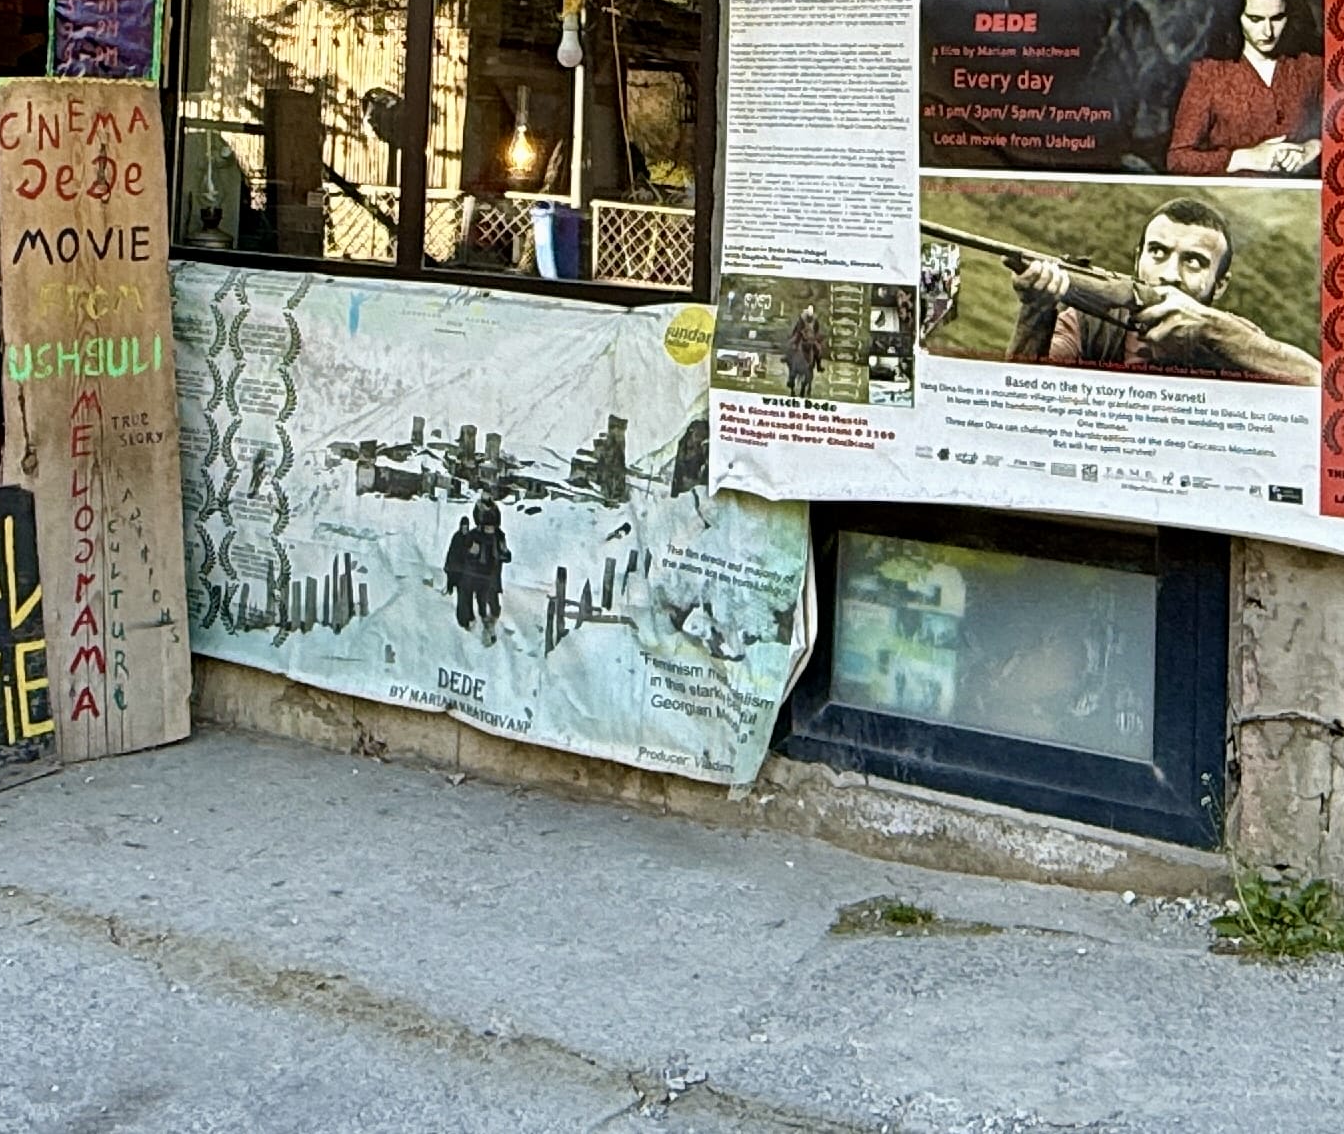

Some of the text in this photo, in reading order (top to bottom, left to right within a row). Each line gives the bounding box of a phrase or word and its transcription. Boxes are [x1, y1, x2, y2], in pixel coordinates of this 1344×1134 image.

[975, 13, 1037, 33] DEDE
[954, 69, 1054, 95] Every day
[934, 132, 1096, 152] Local movie from Ushguli
[13, 226, 150, 265] MOVIE
[1005, 376, 1038, 390] Based
[1042, 381, 1055, 391] on
[1060, 380, 1077, 393] the
[1096, 386, 1125, 399] story
[1129, 386, 1157, 400] from
[1161, 389, 1206, 404] Svaneti
[762, 397, 801, 409] watch
[389, 684, 409, 699] BY
[438, 667, 486, 703] DEDE
[650, 694, 712, 718] Georgian
[638, 746, 689, 766] Producer
